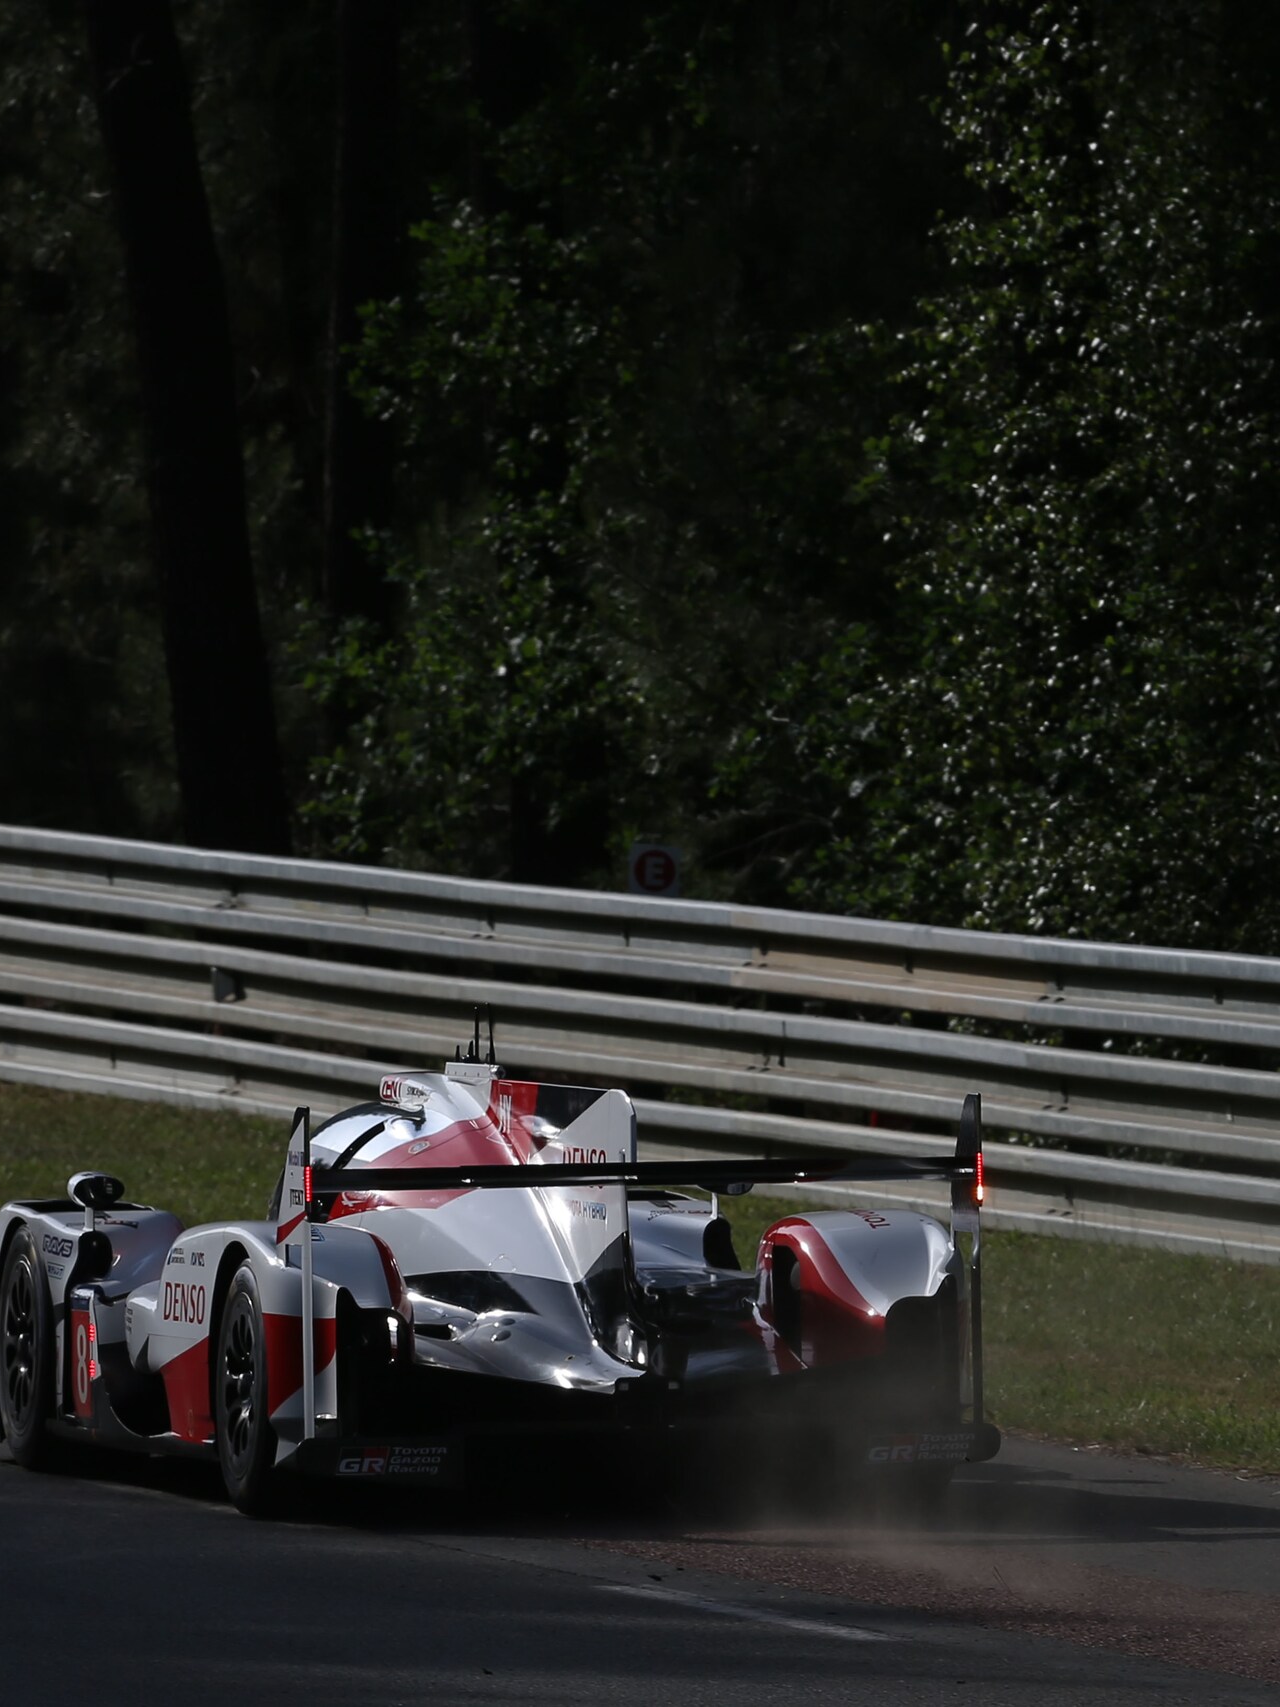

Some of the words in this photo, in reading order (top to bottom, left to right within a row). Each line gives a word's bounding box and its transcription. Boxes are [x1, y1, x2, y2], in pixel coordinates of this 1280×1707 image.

[644, 857, 664, 886] E
[43, 1234, 73, 1257] RAYS
[164, 1282, 205, 1325] DENSO
[77, 1324, 88, 1404] 8
[339, 1457, 384, 1473] GR
[868, 1446, 913, 1461] GR
[389, 1464, 439, 1476] Racing
